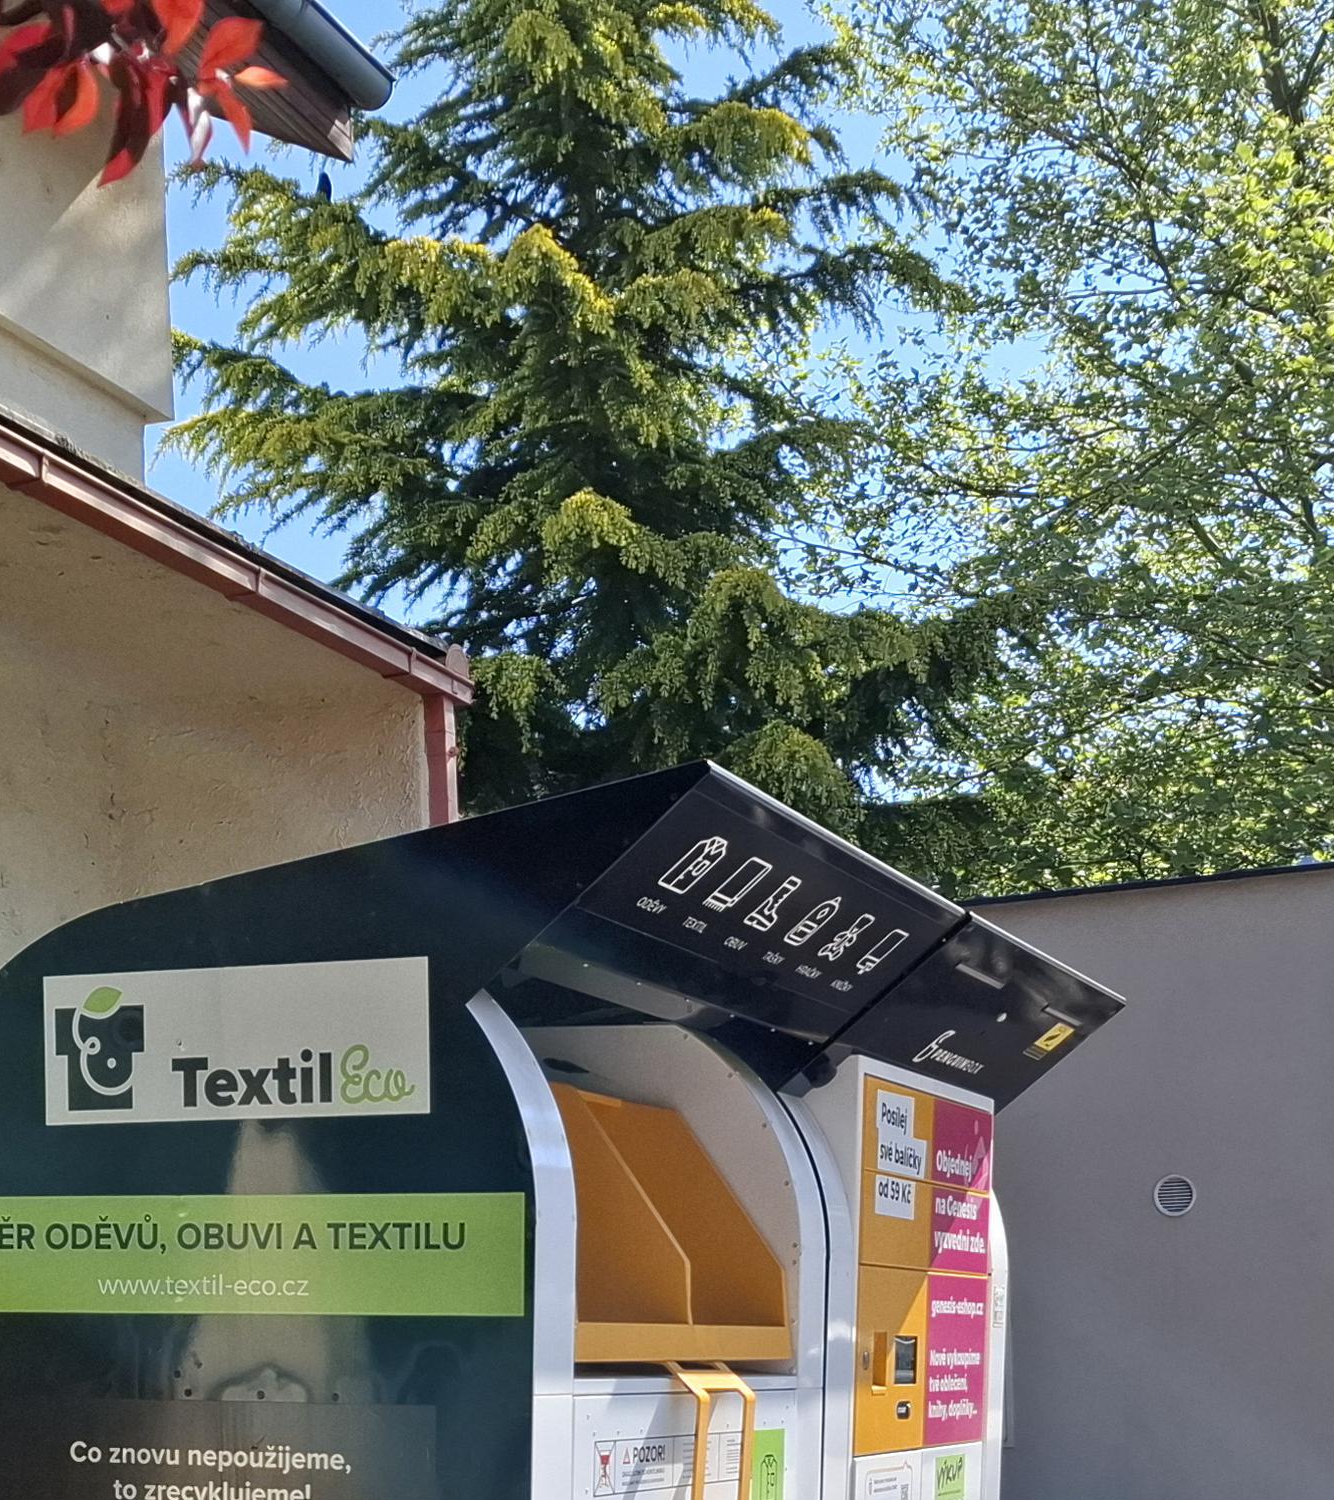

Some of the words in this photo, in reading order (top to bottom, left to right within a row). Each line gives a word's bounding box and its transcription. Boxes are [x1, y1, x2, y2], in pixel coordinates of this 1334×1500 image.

[881, 1102, 907, 1135] Posílej
[880, 1141, 893, 1162] své
[895, 1143, 922, 1175] balíčky
[936, 1149, 972, 1182] Objednej
[878, 1178, 889, 1198] od
[890, 1181, 900, 1201] 59
[901, 1184, 911, 1204] Kč
[935, 1197, 945, 1216] na
[947, 1195, 977, 1220] Genesis
[46, 1214, 167, 1254] ODĚVŮ,
[177, 1221, 283, 1251] OBUVI
[292, 1222, 317, 1250] A
[327, 1221, 466, 1250] TEXTILU
[98, 1274, 309, 1298] www.textil-eco.cz
[931, 1296, 984, 1319] genesis-eshop.cz
[69, 1441, 102, 1463] Co
[109, 1446, 179, 1465] znovu
[188, 1445, 352, 1474] nepoužijeme,
[632, 1443, 666, 1464] POZOR!
[113, 1480, 137, 1500] to
